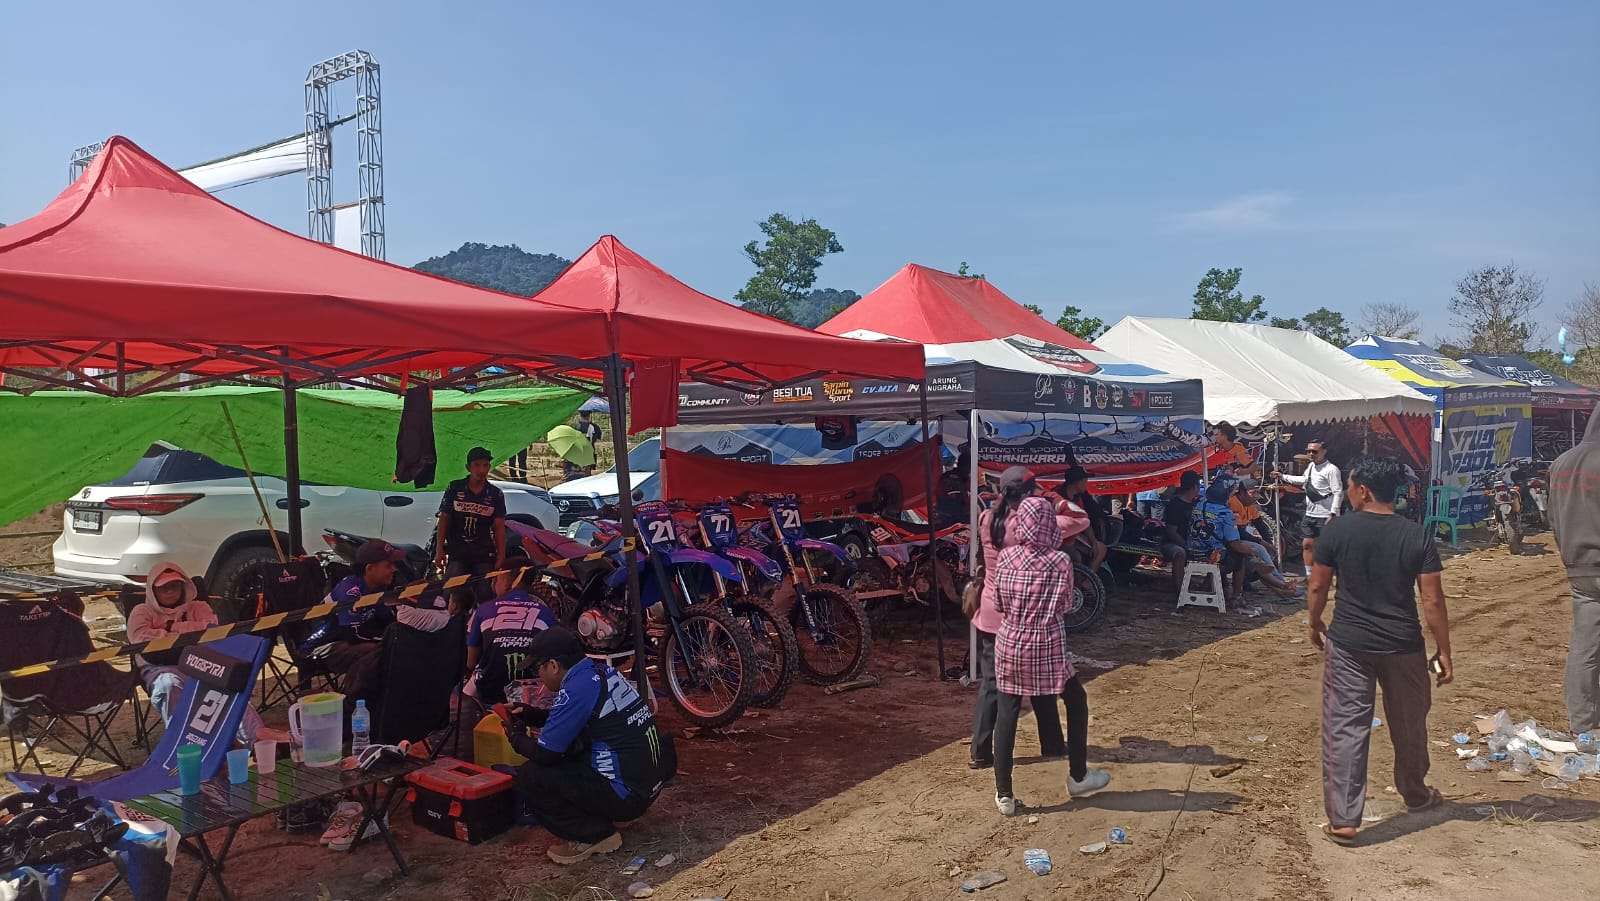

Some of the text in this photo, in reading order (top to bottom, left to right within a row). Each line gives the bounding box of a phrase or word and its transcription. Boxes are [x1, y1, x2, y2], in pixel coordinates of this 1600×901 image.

[927, 383, 962, 392] NUGRAHA
[932, 377, 957, 385] ARUNG
[773, 387, 813, 398] BESI TUA
[686, 398, 731, 407] COMMUNITY
[711, 515, 730, 533] 77
[782, 509, 801, 528] 21
[648, 519, 676, 544] 21
[492, 606, 540, 631] 21
[189, 689, 229, 735] 21
